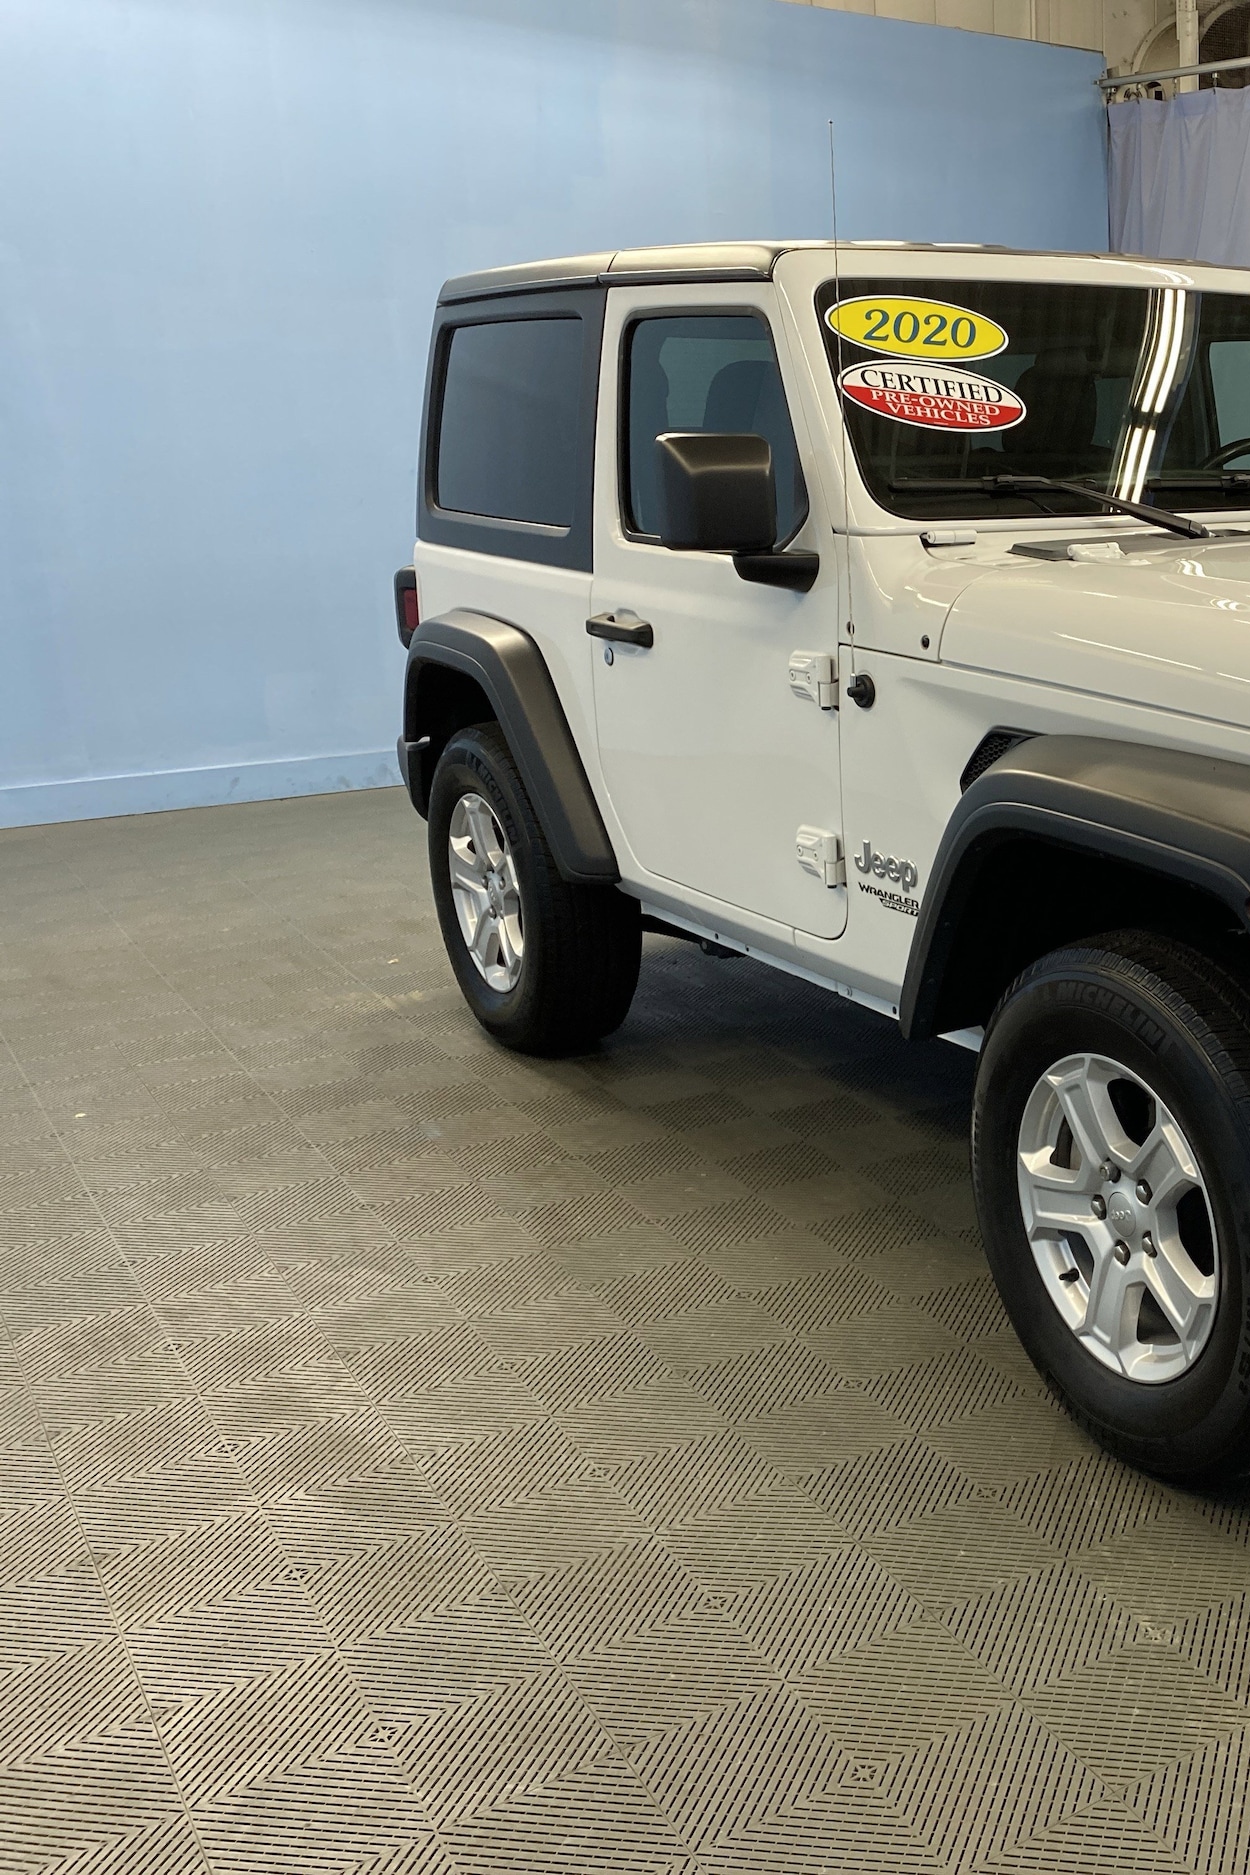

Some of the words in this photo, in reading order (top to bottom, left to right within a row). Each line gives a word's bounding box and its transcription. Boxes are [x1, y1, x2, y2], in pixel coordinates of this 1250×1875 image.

[863, 309, 976, 348] 2020
[860, 369, 1003, 403] CERTIFIED
[871, 389, 1000, 416] PRE-OWNED
[886, 403, 991, 425] VEHICLES
[854, 839, 918, 893] Jeep
[858, 882, 919, 909] WRANGLER
[882, 899, 919, 916] SPORT
[1056, 981, 1167, 1050] MICHELIN
